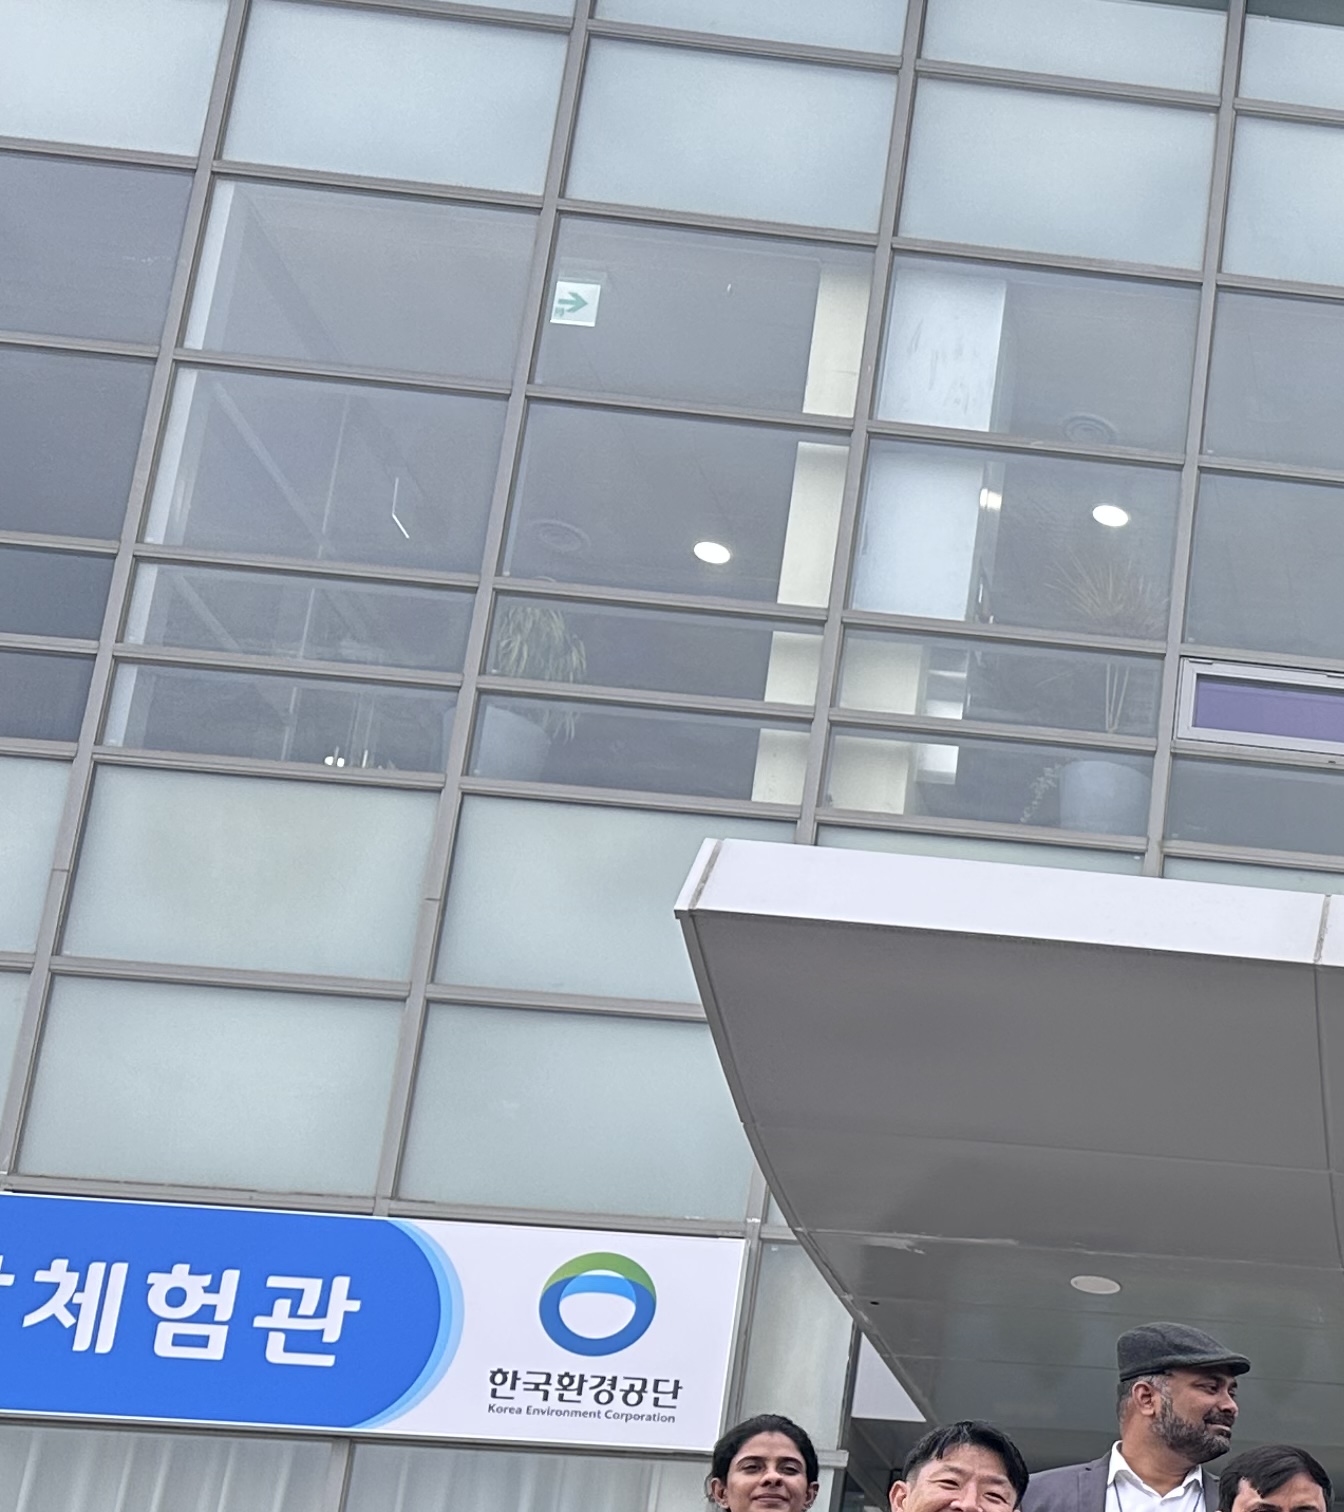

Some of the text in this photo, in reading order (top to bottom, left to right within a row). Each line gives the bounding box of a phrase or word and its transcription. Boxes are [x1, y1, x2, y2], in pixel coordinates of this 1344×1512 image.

[0, 1255, 361, 1367] 체험관
[489, 1368, 683, 1409] 한국환경공단
[488, 1404, 676, 1423] Korea Environment Corporation
